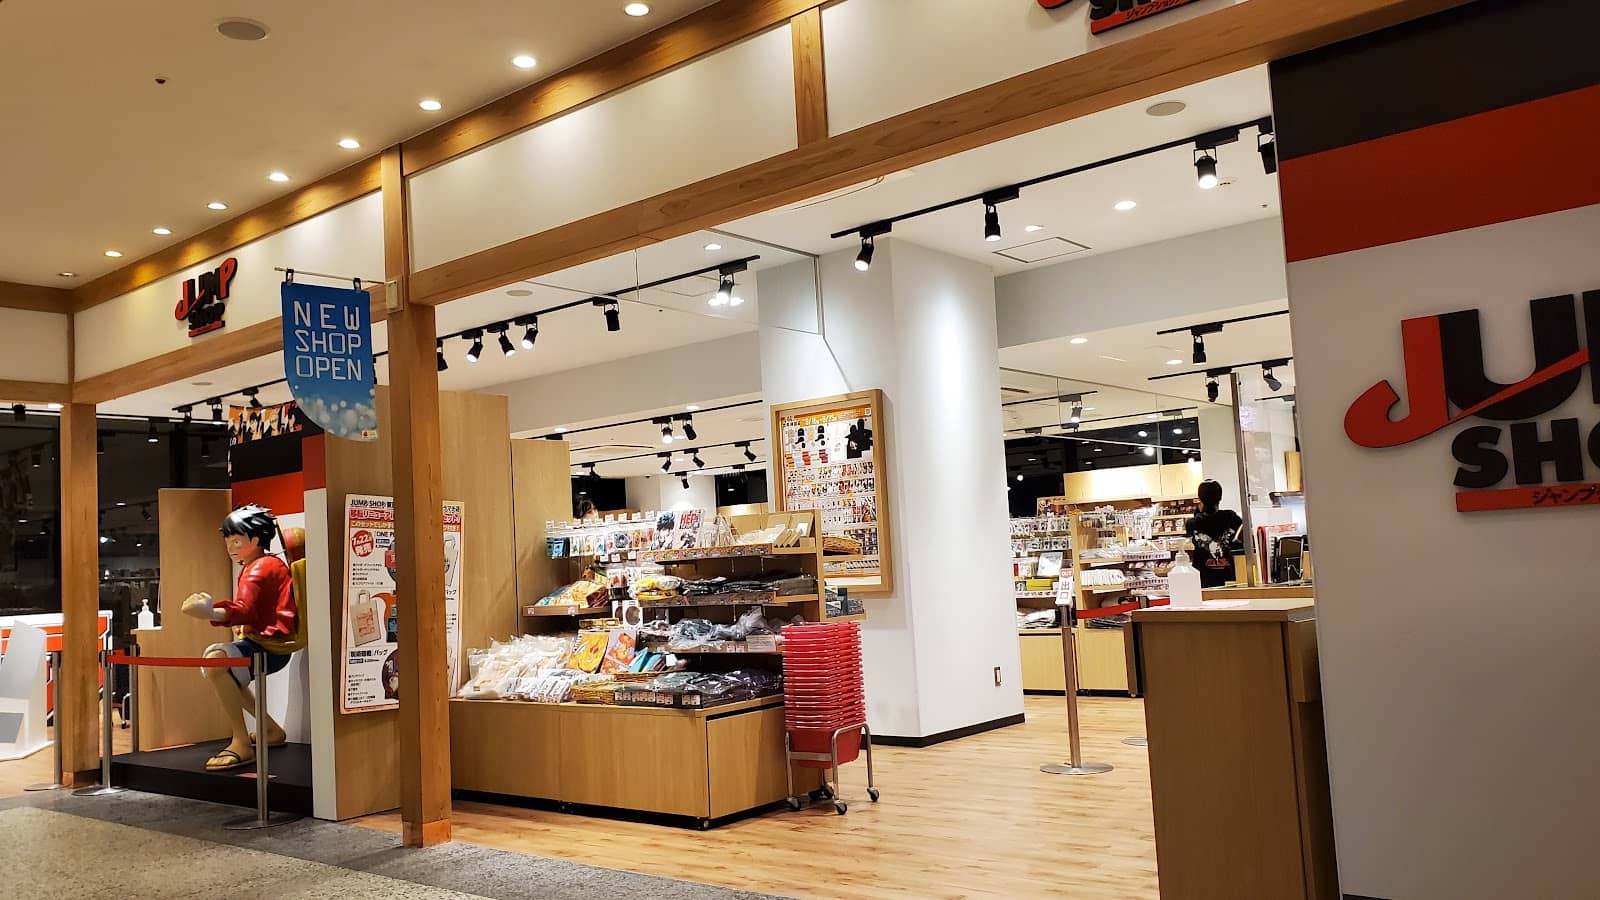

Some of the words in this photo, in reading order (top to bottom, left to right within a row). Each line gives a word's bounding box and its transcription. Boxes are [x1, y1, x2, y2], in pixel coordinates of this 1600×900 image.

[174, 257, 237, 320] JUMP
[188, 302, 225, 330] SHOP
[293, 300, 360, 331] NEW
[294, 329, 362, 356] SHOP
[295, 354, 362, 382] OPEN
[350, 499, 368, 507] JUMP
[369, 500, 386, 508] SHOP
[1531, 485, 1600, 505] ジャンプ
[1060, 581, 1070, 600] 出口
